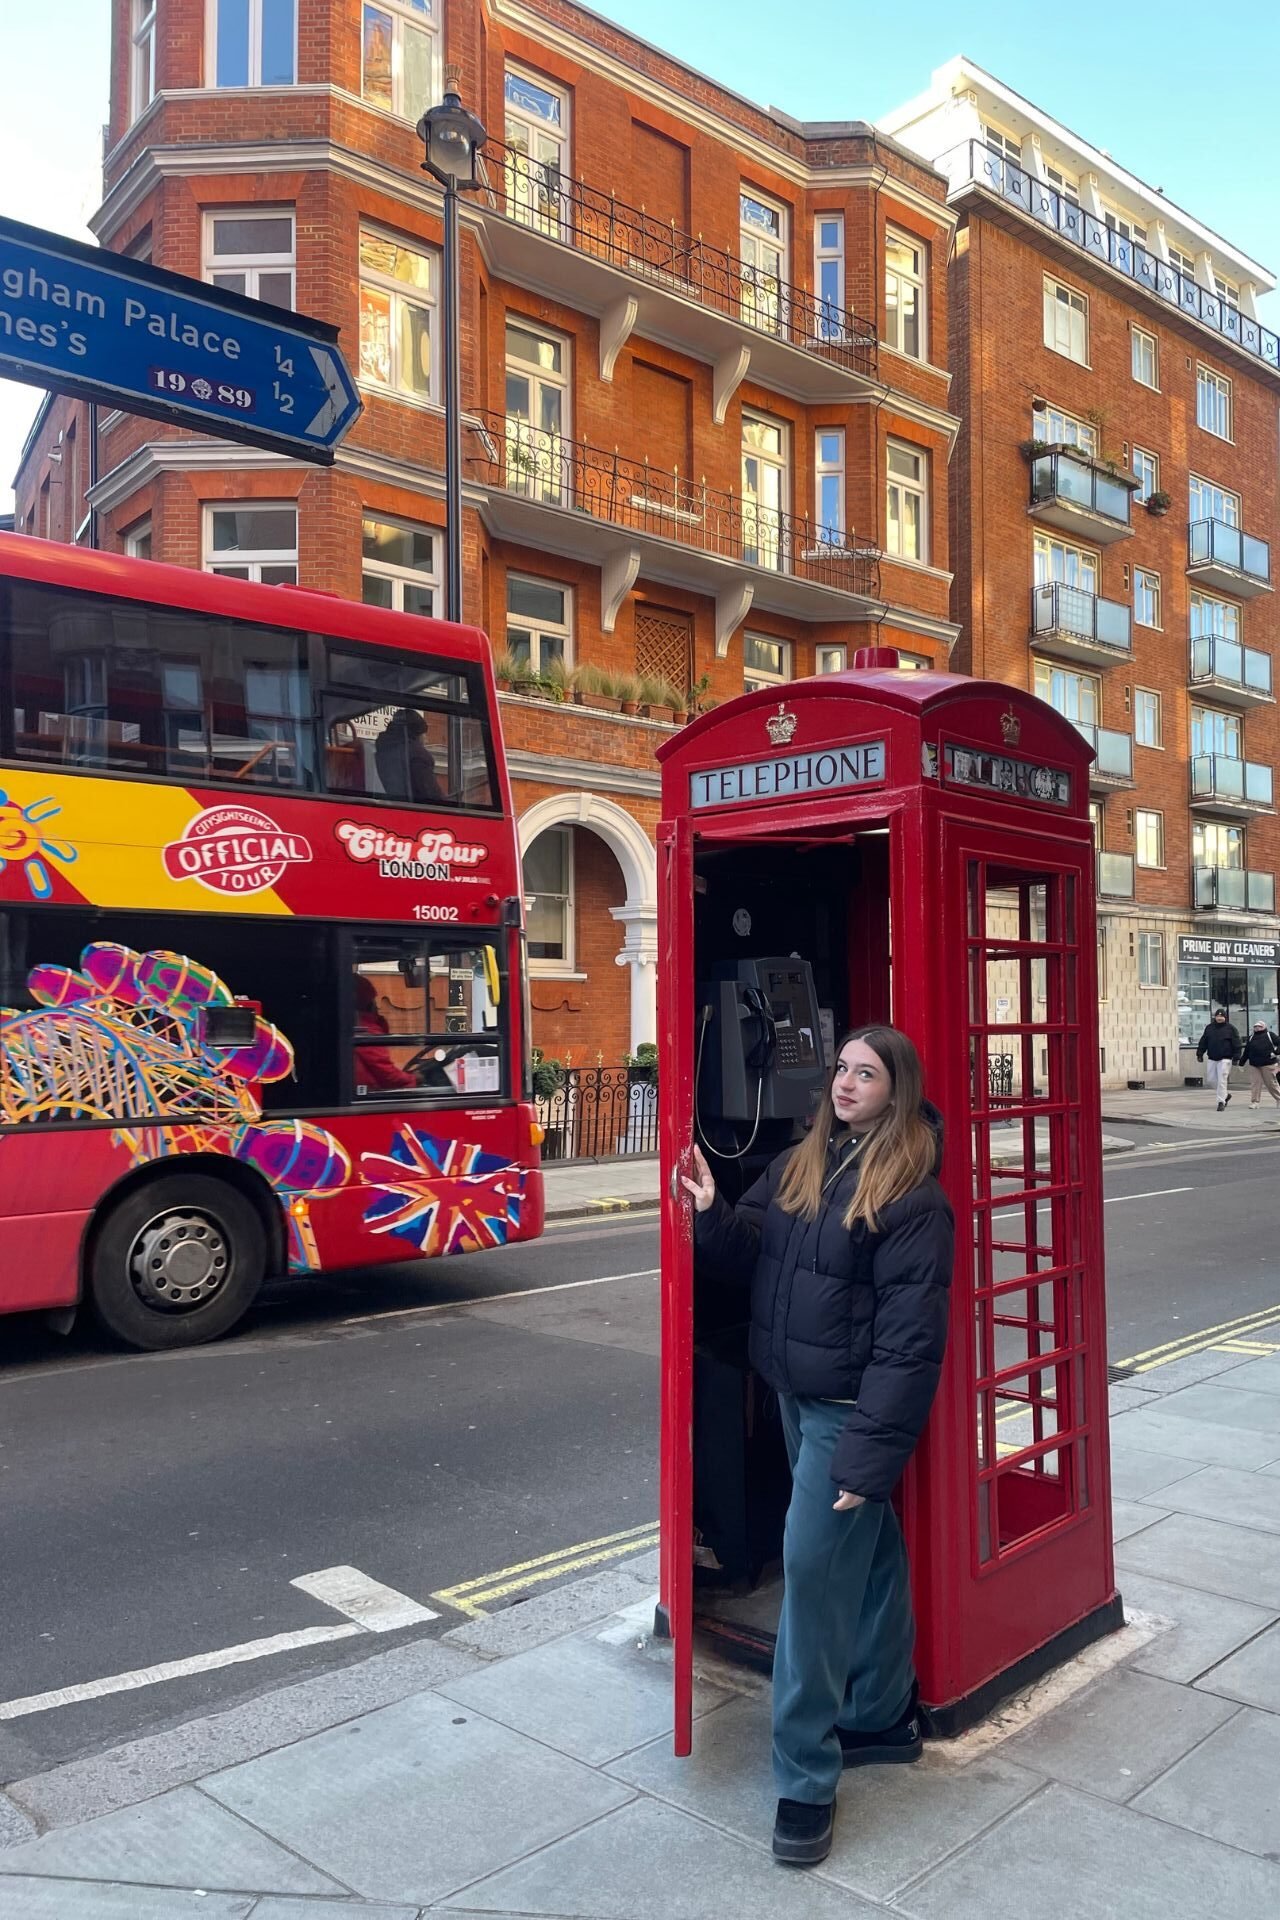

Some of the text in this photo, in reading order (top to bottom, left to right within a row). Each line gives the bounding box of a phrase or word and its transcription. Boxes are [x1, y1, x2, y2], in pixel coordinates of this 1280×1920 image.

[125, 298, 241, 360] Palace
[699, 746, 880, 802] TELEPHONE
[195, 811, 272, 835] CITYSIGHTSEEING
[178, 837, 304, 872] OFFICIAL
[338, 824, 486, 864] City Tour
[220, 866, 276, 889] TOUR
[381, 860, 449, 880] LONDON
[412, 905, 459, 921] 15002
[1183, 939, 1275, 957] PRIME DRY CLEANERS
